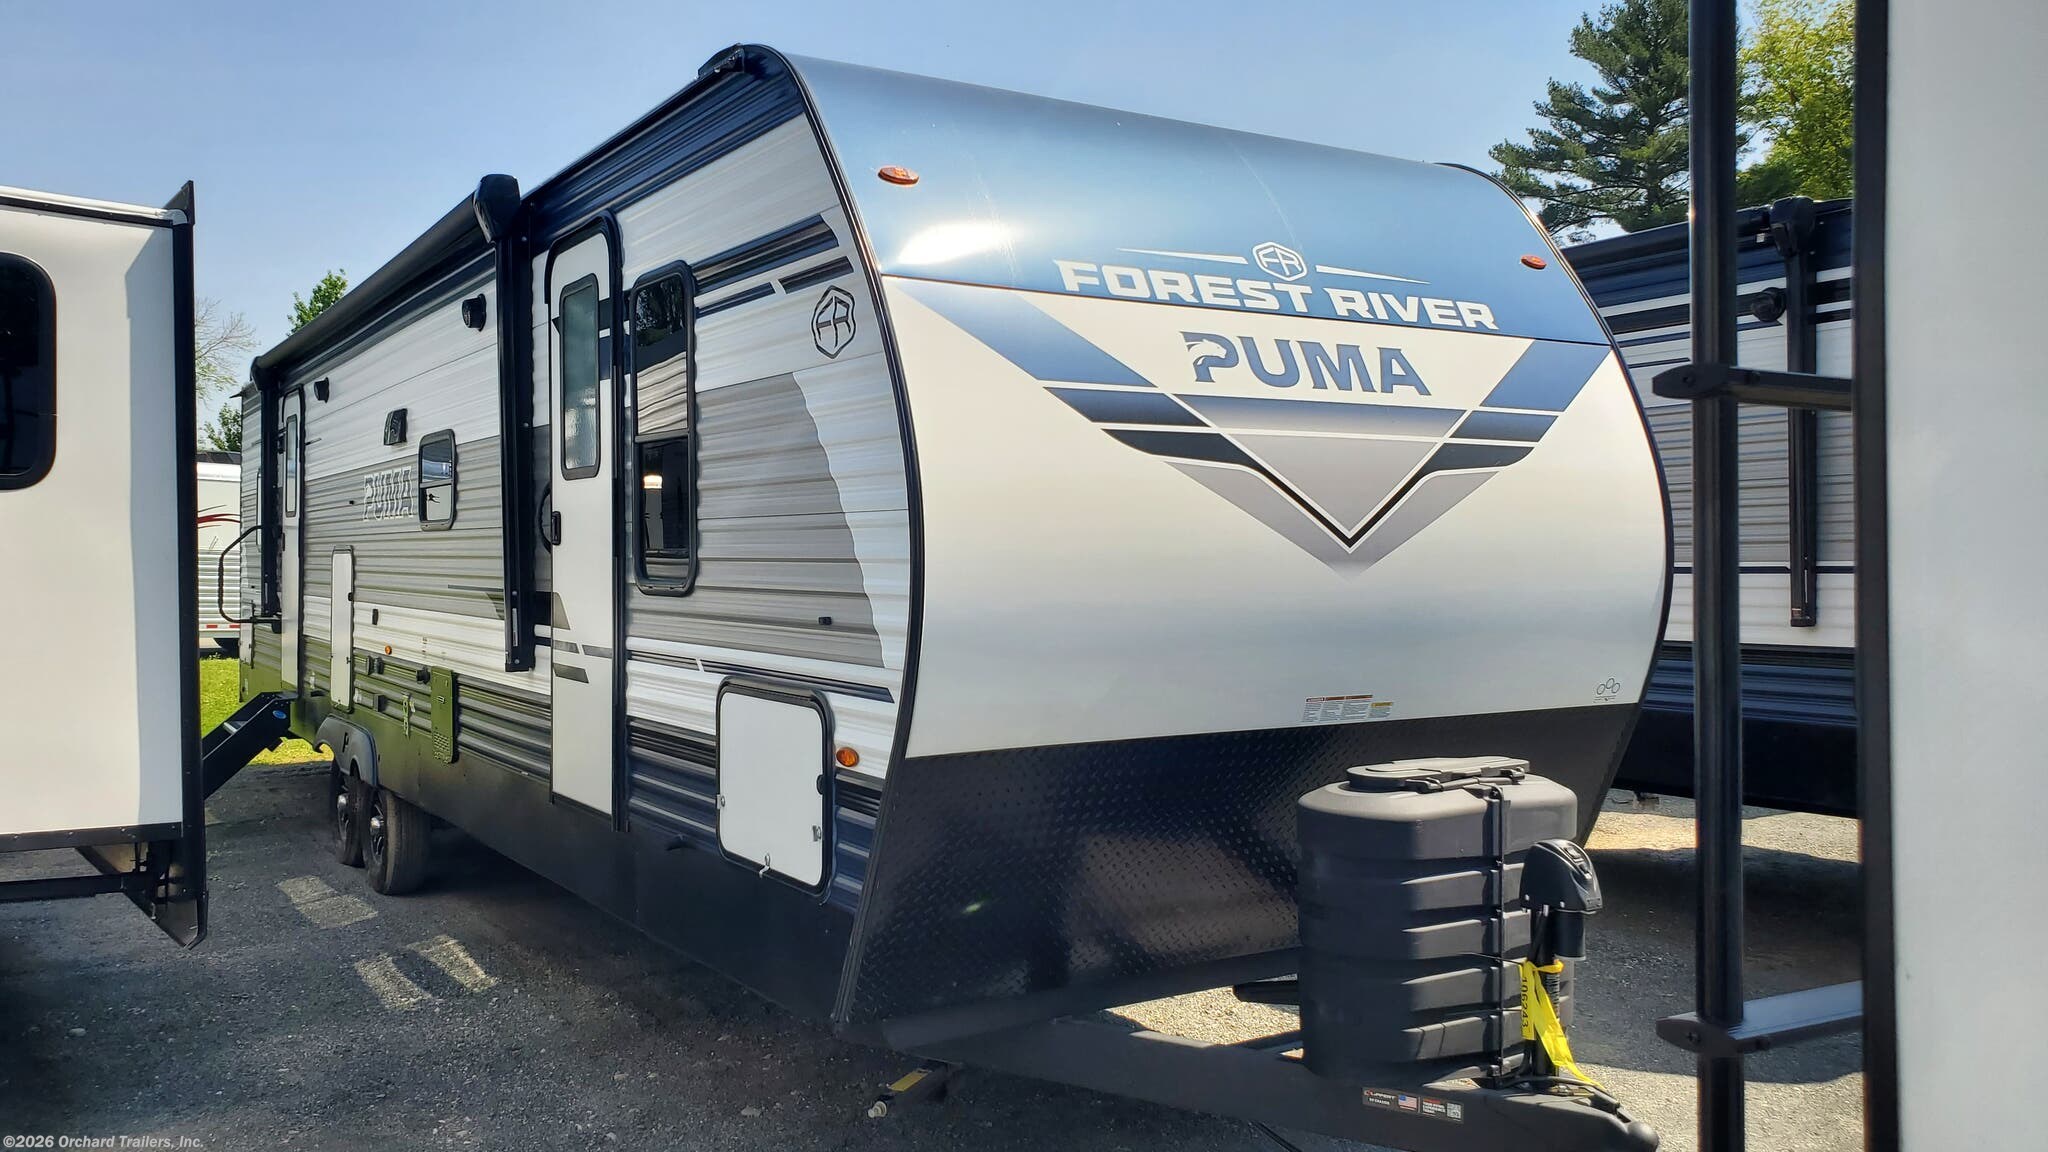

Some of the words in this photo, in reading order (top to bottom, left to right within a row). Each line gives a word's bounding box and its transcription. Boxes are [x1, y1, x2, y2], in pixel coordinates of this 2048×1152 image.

[1052, 259, 1313, 313] FOREST
[1322, 287, 1500, 330] RIVER
[1179, 331, 1432, 396] PUMA
[363, 465, 414, 522] PUMA
